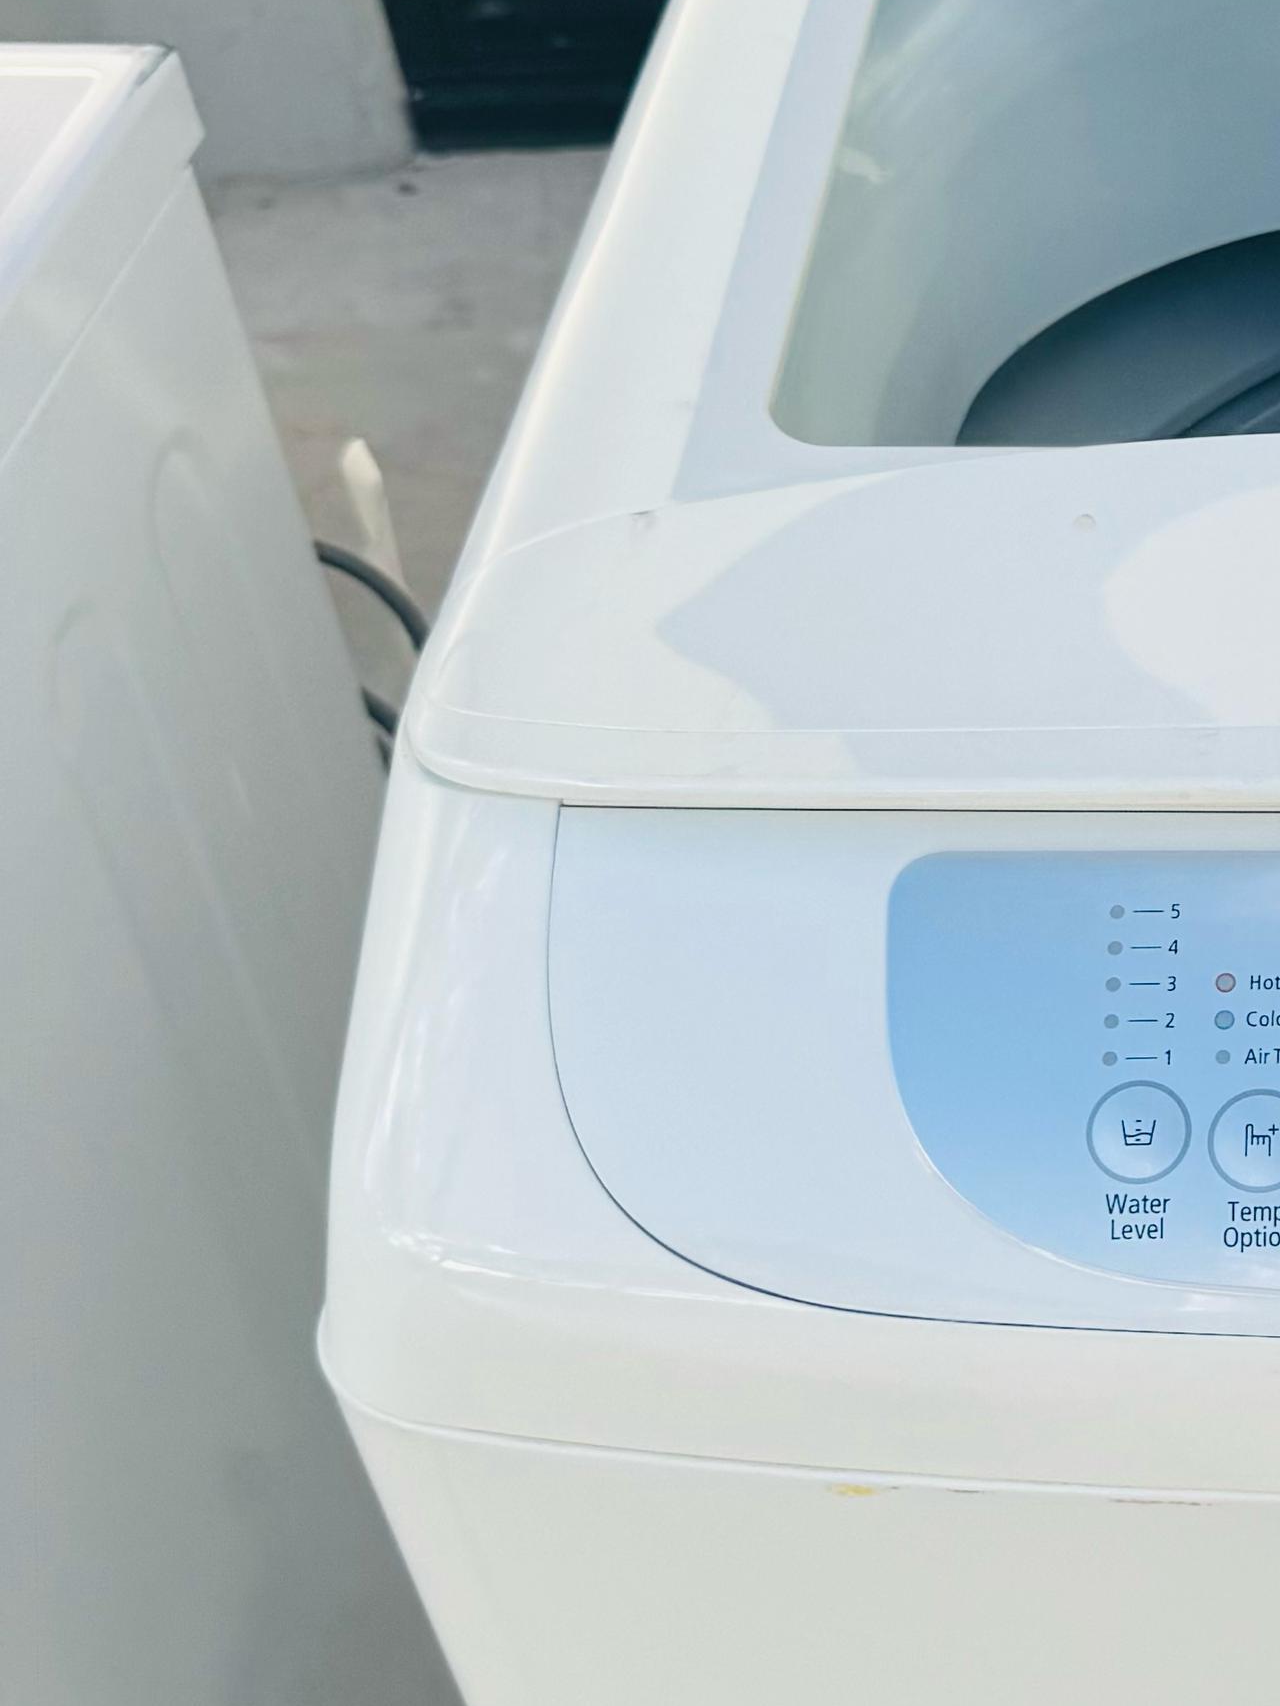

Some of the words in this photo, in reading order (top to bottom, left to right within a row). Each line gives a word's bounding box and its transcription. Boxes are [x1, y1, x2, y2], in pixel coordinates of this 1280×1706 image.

[1171, 903, 1181, 919] 5
[1168, 939, 1178, 955] 4
[1167, 975, 1177, 992] 3
[1250, 974, 1280, 990] Hot
[1165, 1012, 1175, 1029] 2
[1165, 1049, 1171, 1066] 1
[1244, 1047, 1271, 1065] Air
[1104, 1192, 1171, 1216] Water
[1110, 1218, 1165, 1241] Level
